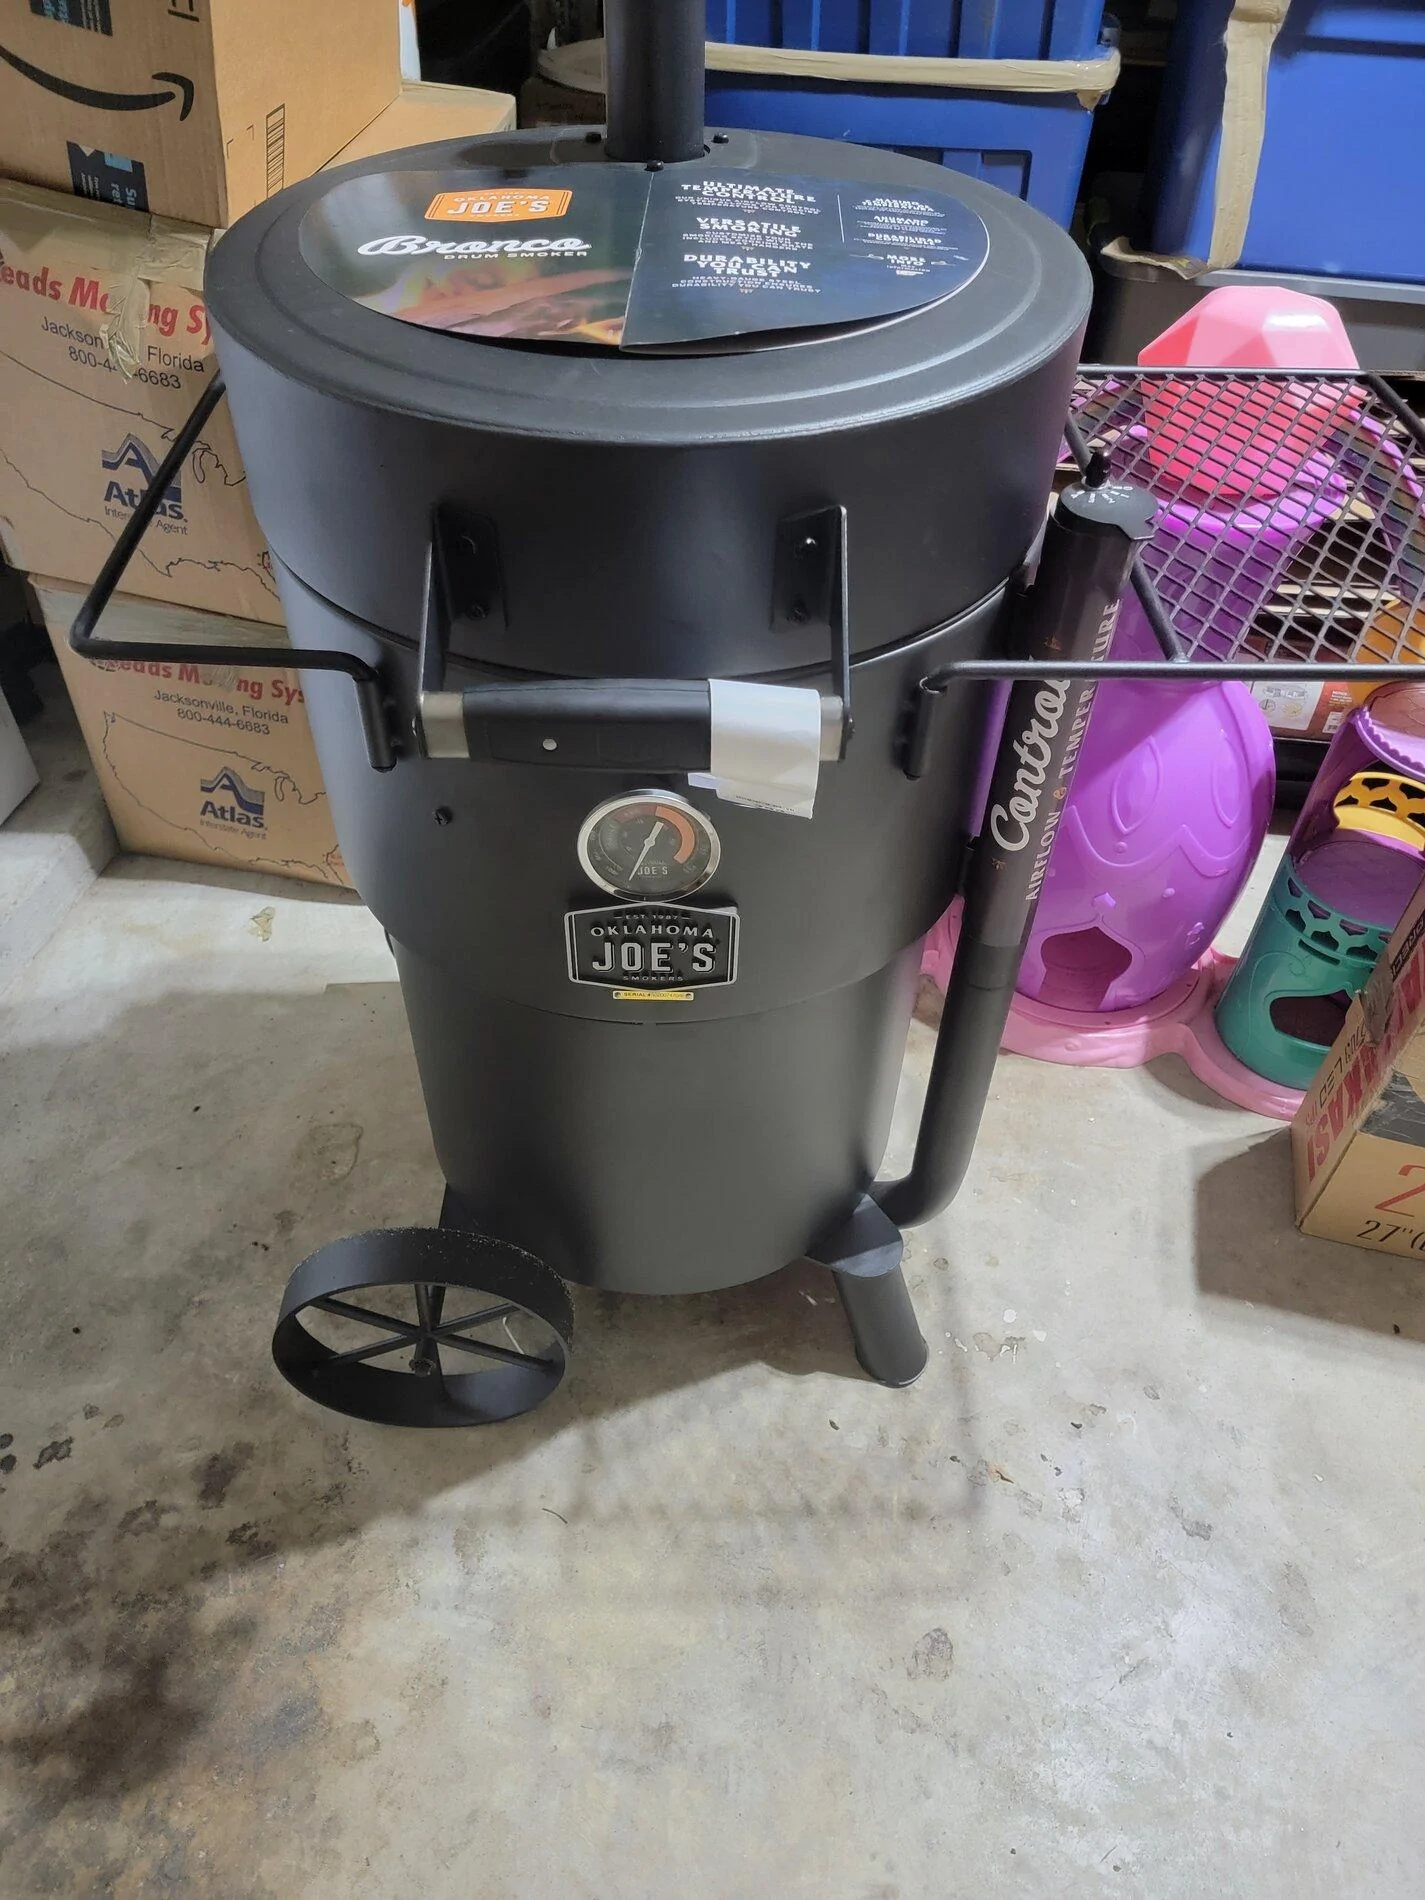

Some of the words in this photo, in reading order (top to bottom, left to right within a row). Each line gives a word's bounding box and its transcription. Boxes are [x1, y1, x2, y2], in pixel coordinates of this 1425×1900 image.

[680, 184, 817, 203] TEMPERATURE
[702, 180, 795, 195] ULTIMATE
[701, 190, 796, 204] CONTROL
[447, 200, 550, 214] JOE'S
[696, 217, 802, 233] VERSATILE
[699, 223, 798, 238] SMOKING
[357, 235, 592, 256] Bronco
[507, 251, 588, 259] SMOKER
[683, 254, 812, 269] DURABILITY
[696, 260, 742, 269] YOU
[751, 262, 798, 274] CAN
[713, 267, 782, 278] TRUST
[0, 265, 63, 301] eads
[147, 345, 205, 373] Florida
[68, 346, 182, 390] 800-4-6683
[154, 689, 239, 716] Jacksonville,
[242, 704, 290, 724] Florida
[177, 707, 271, 736] 800-444-6683
[1025, 811, 1061, 901] AIRFLOW
[1058, 598, 1121, 779] TEMPERTURE
[200, 800, 265, 829] Atlas
[590, 924, 714, 938] OKLAHOMA
[592, 941, 717, 974] JOE'S
